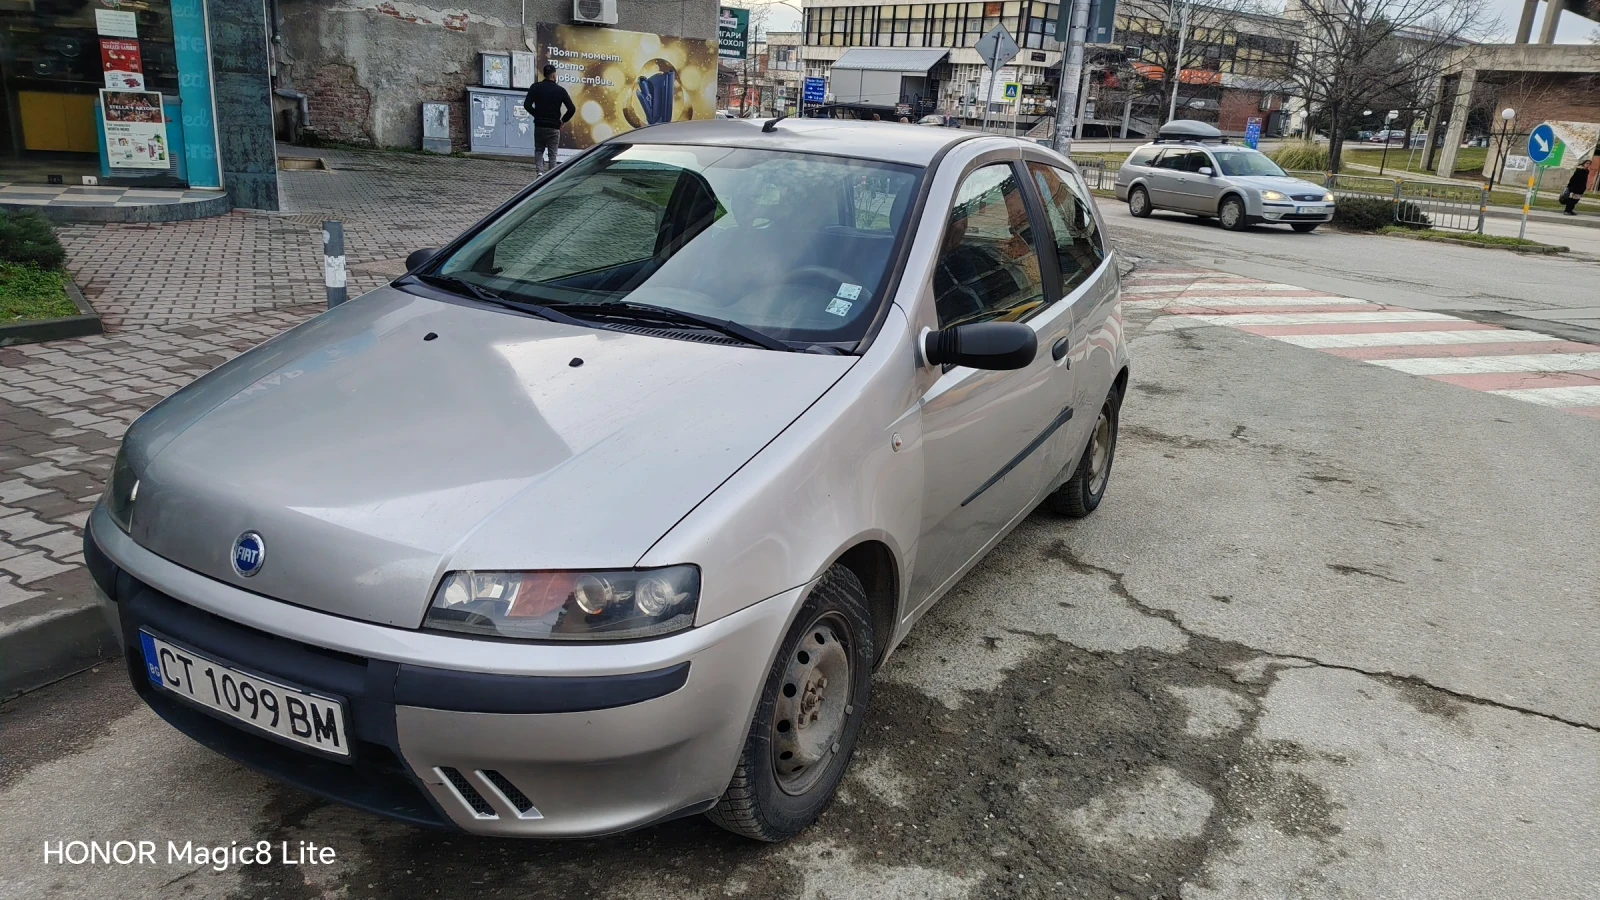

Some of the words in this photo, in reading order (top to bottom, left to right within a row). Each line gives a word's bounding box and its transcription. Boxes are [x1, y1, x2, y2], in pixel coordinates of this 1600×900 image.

[719, 31, 741, 39] ИГАРИ
[719, 39, 744, 47] КОХОЛ
[547, 46, 579, 58] Твоят
[581, 52, 622, 62] момент.
[548, 59, 585, 71] Твоето
[556, 73, 614, 86] оволствие.
[236, 545, 259, 564] FIAT
[149, 662, 161, 677] BG
[160, 647, 194, 695] CT
[204, 667, 279, 728] 1099
[285, 695, 340, 748] BM
